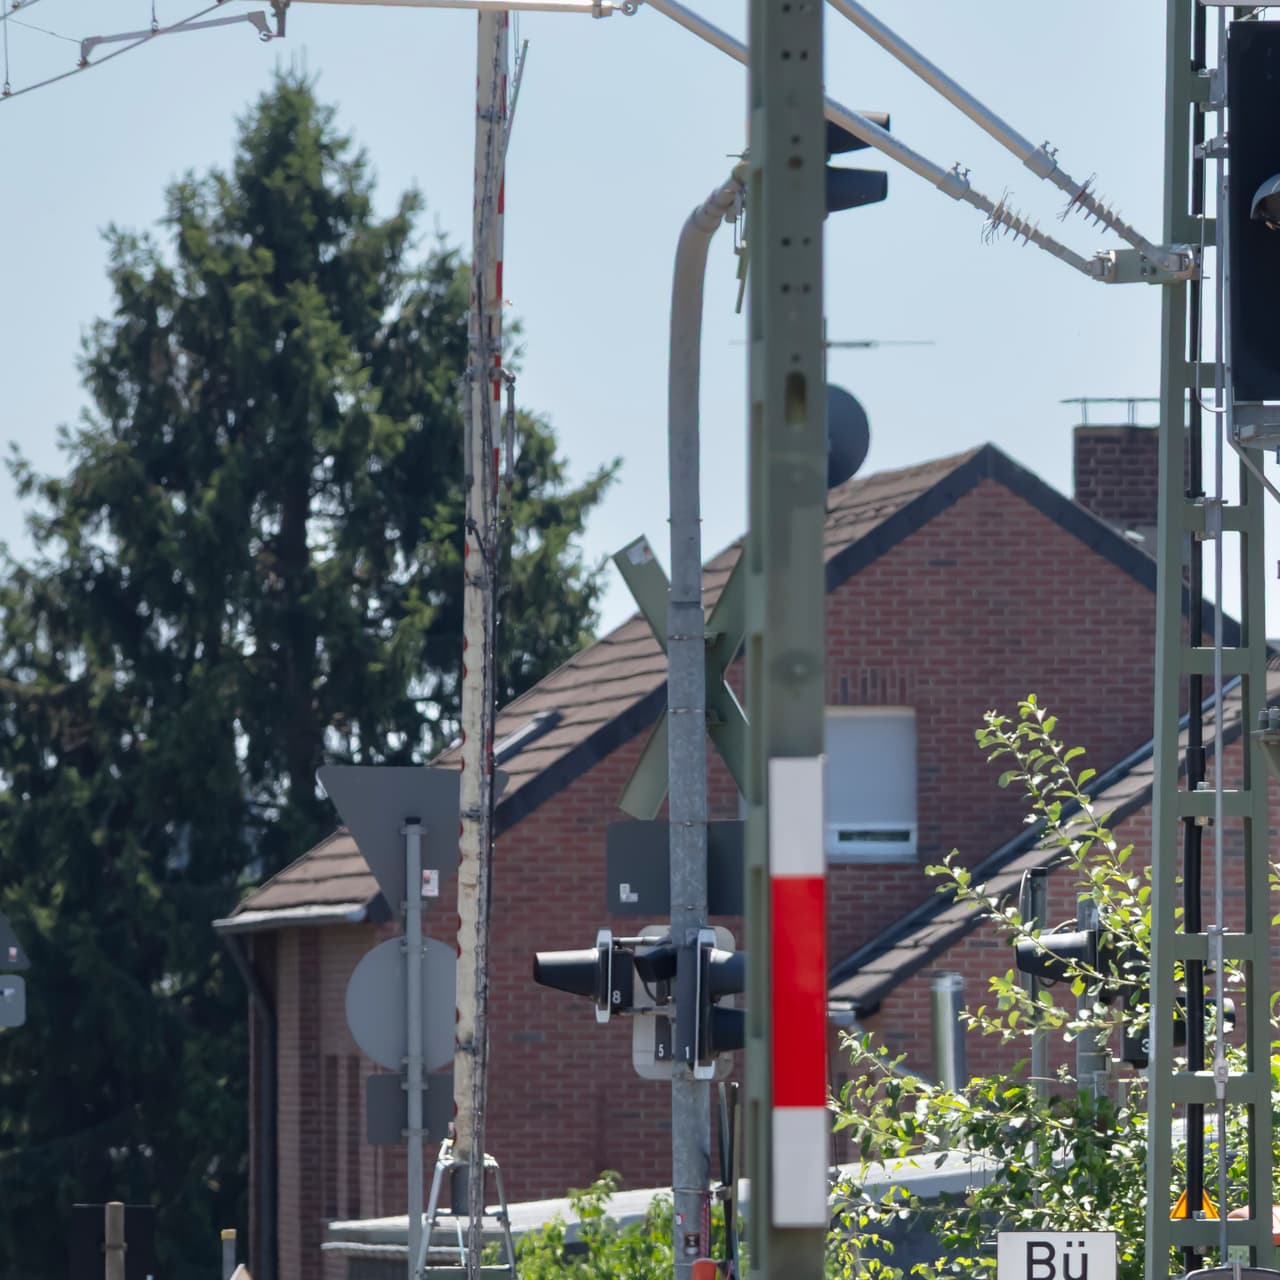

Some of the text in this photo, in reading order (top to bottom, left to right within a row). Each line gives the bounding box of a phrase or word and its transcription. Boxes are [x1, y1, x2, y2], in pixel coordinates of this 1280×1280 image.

[612, 990, 621, 1004] 8
[658, 1044, 664, 1057] 5
[685, 1046, 690, 1059] 1
